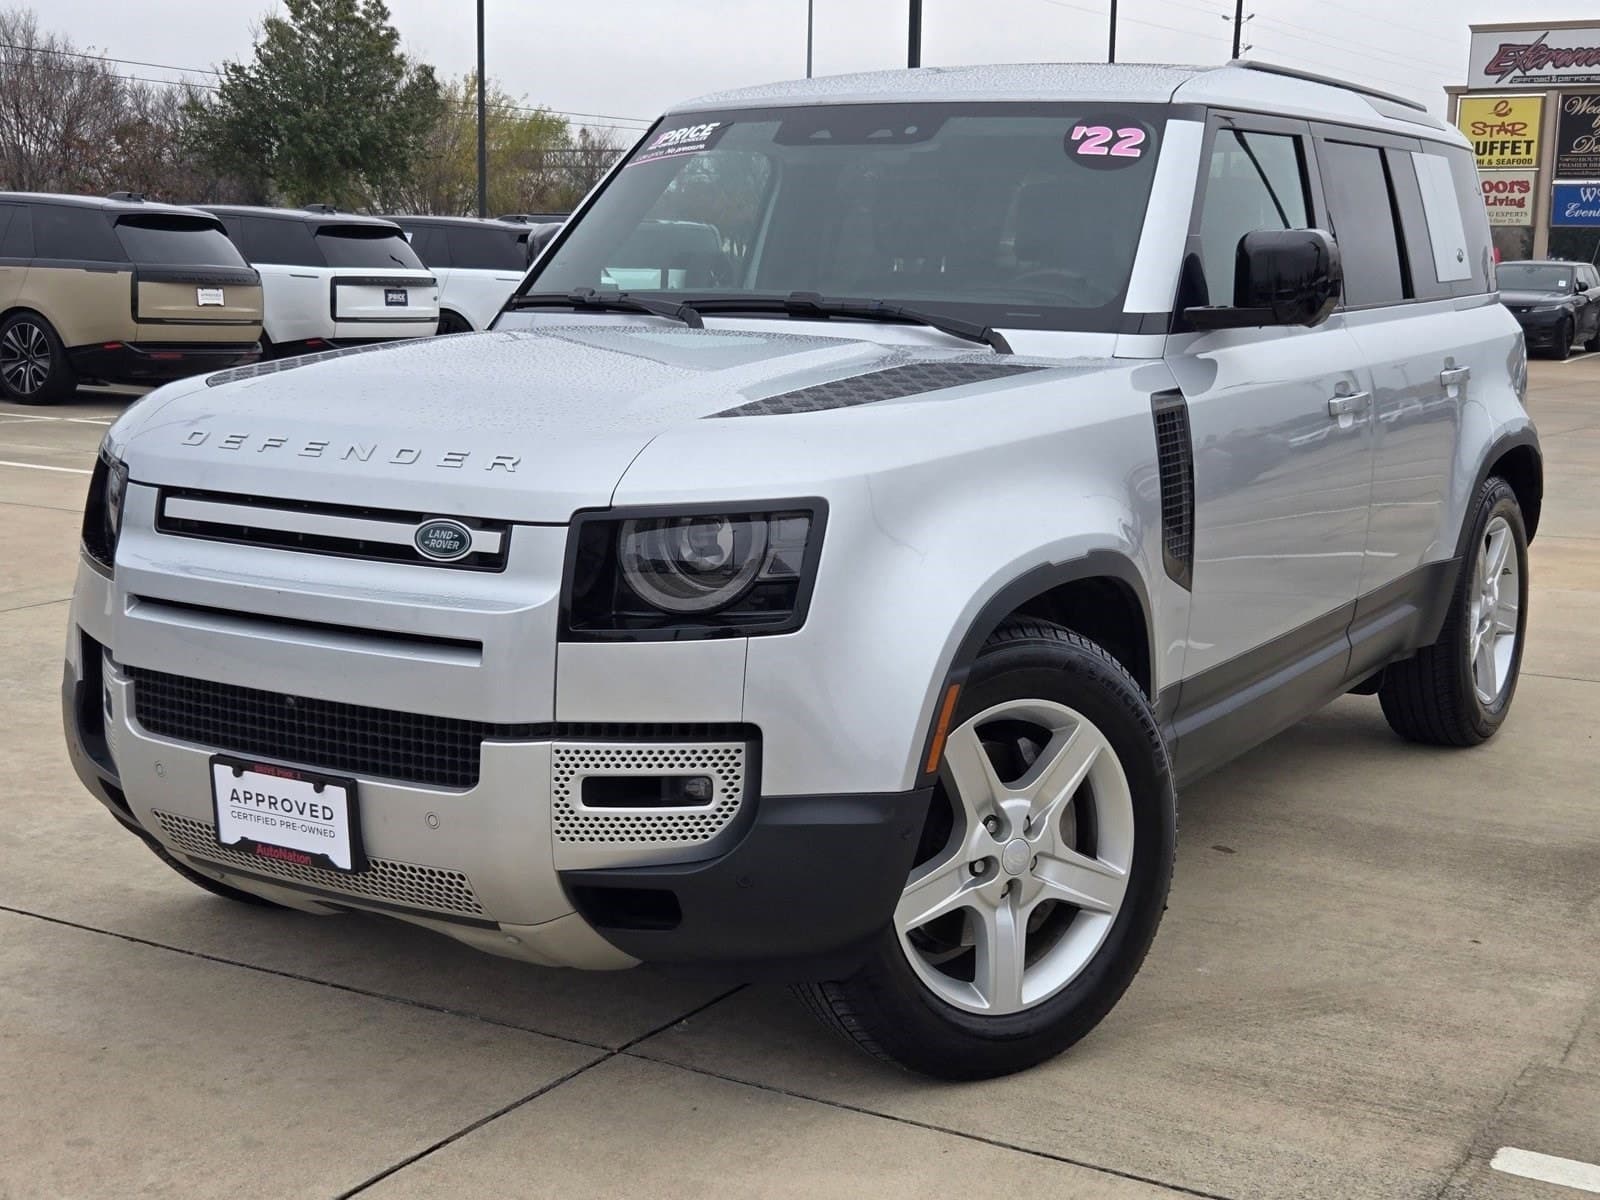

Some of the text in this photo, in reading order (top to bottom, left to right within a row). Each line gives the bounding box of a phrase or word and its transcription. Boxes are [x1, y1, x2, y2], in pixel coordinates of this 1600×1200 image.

[1471, 121, 1528, 138] STAR
[1496, 158, 1533, 166] SEAFOOD
[1484, 195, 1526, 208] Living
[181, 430, 522, 473] DEFENDER
[229, 788, 334, 821] APPROVED
[230, 810, 336, 839] CERTIFIED PRE-OWNED
[256, 844, 312, 865] AutoNation
